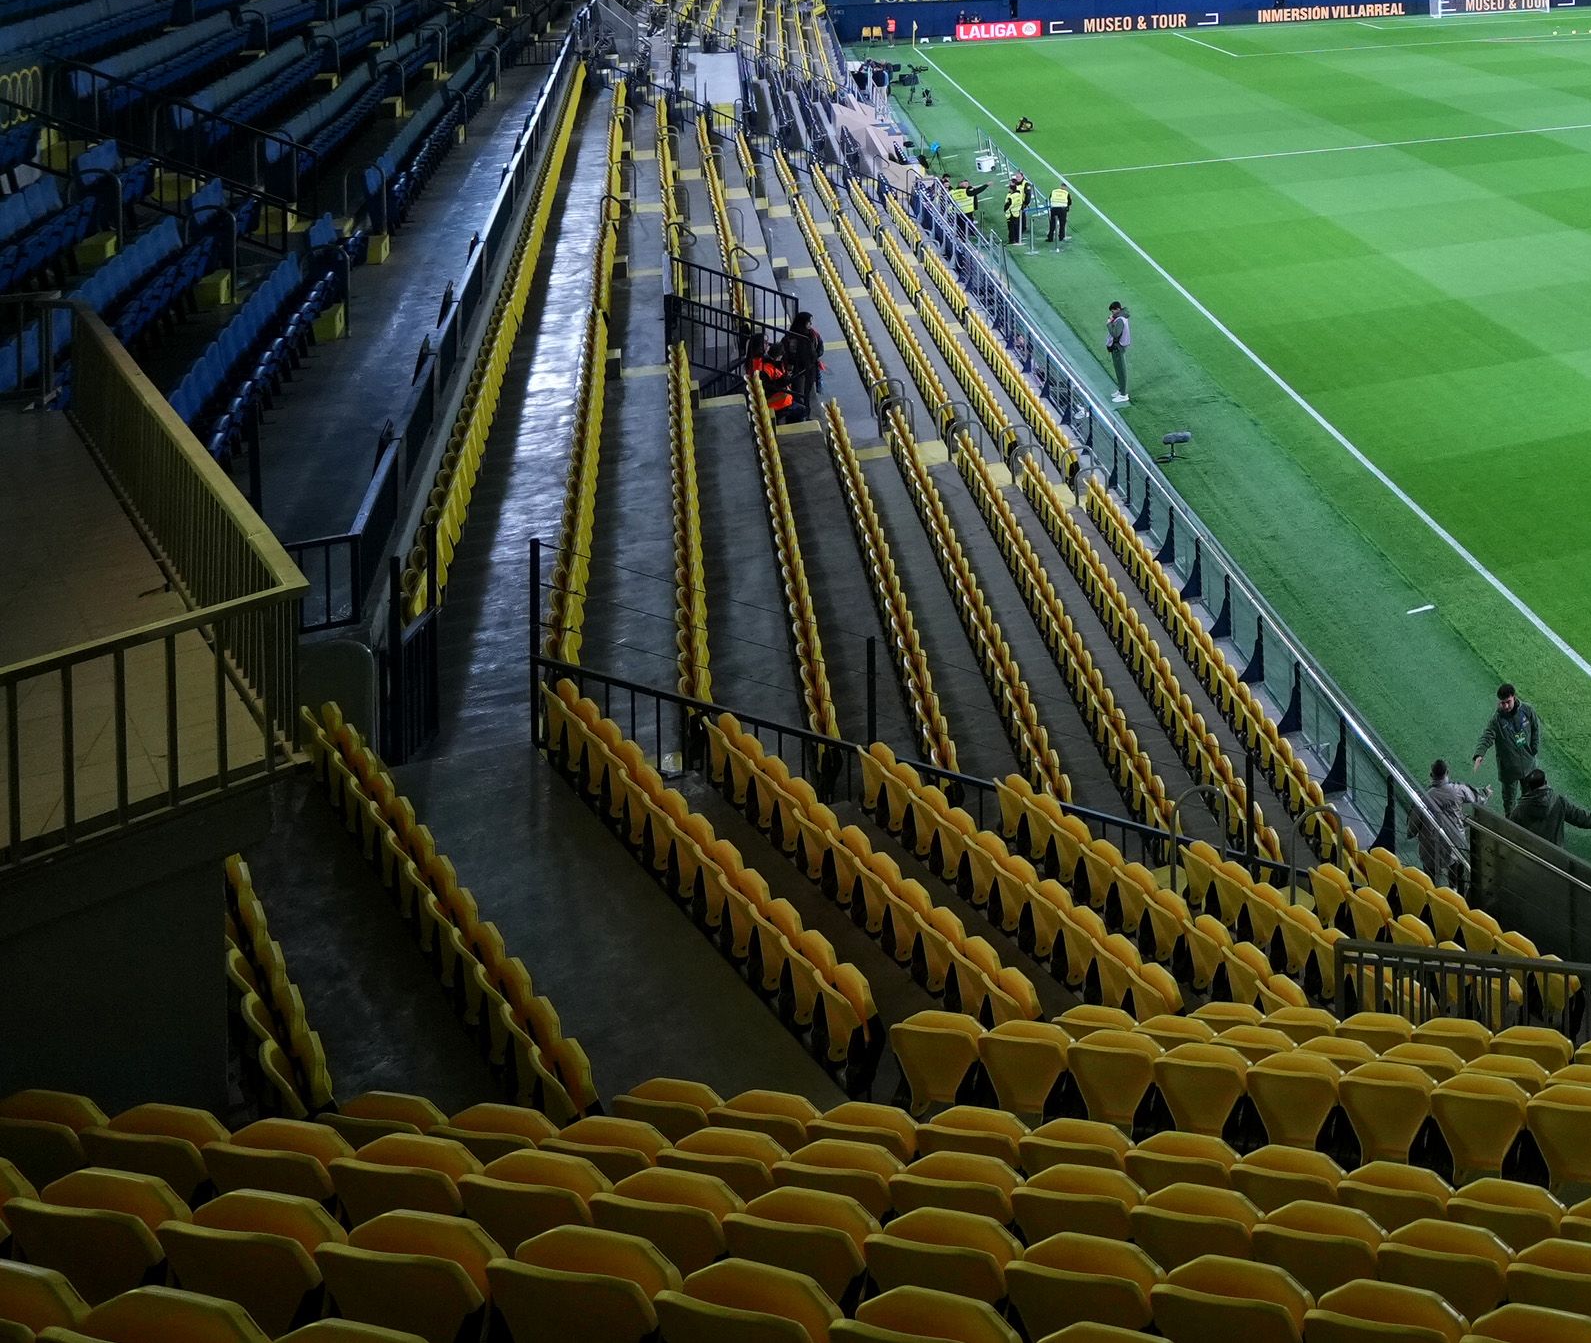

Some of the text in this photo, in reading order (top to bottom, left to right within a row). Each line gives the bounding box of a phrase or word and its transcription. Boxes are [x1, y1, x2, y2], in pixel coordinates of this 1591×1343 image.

[1257, 2, 1405, 23] INMERSIÓN VILLARREAL
[959, 23, 1018, 40] LALIGA
[1083, 13, 1187, 33] MUSEO & TOUR
